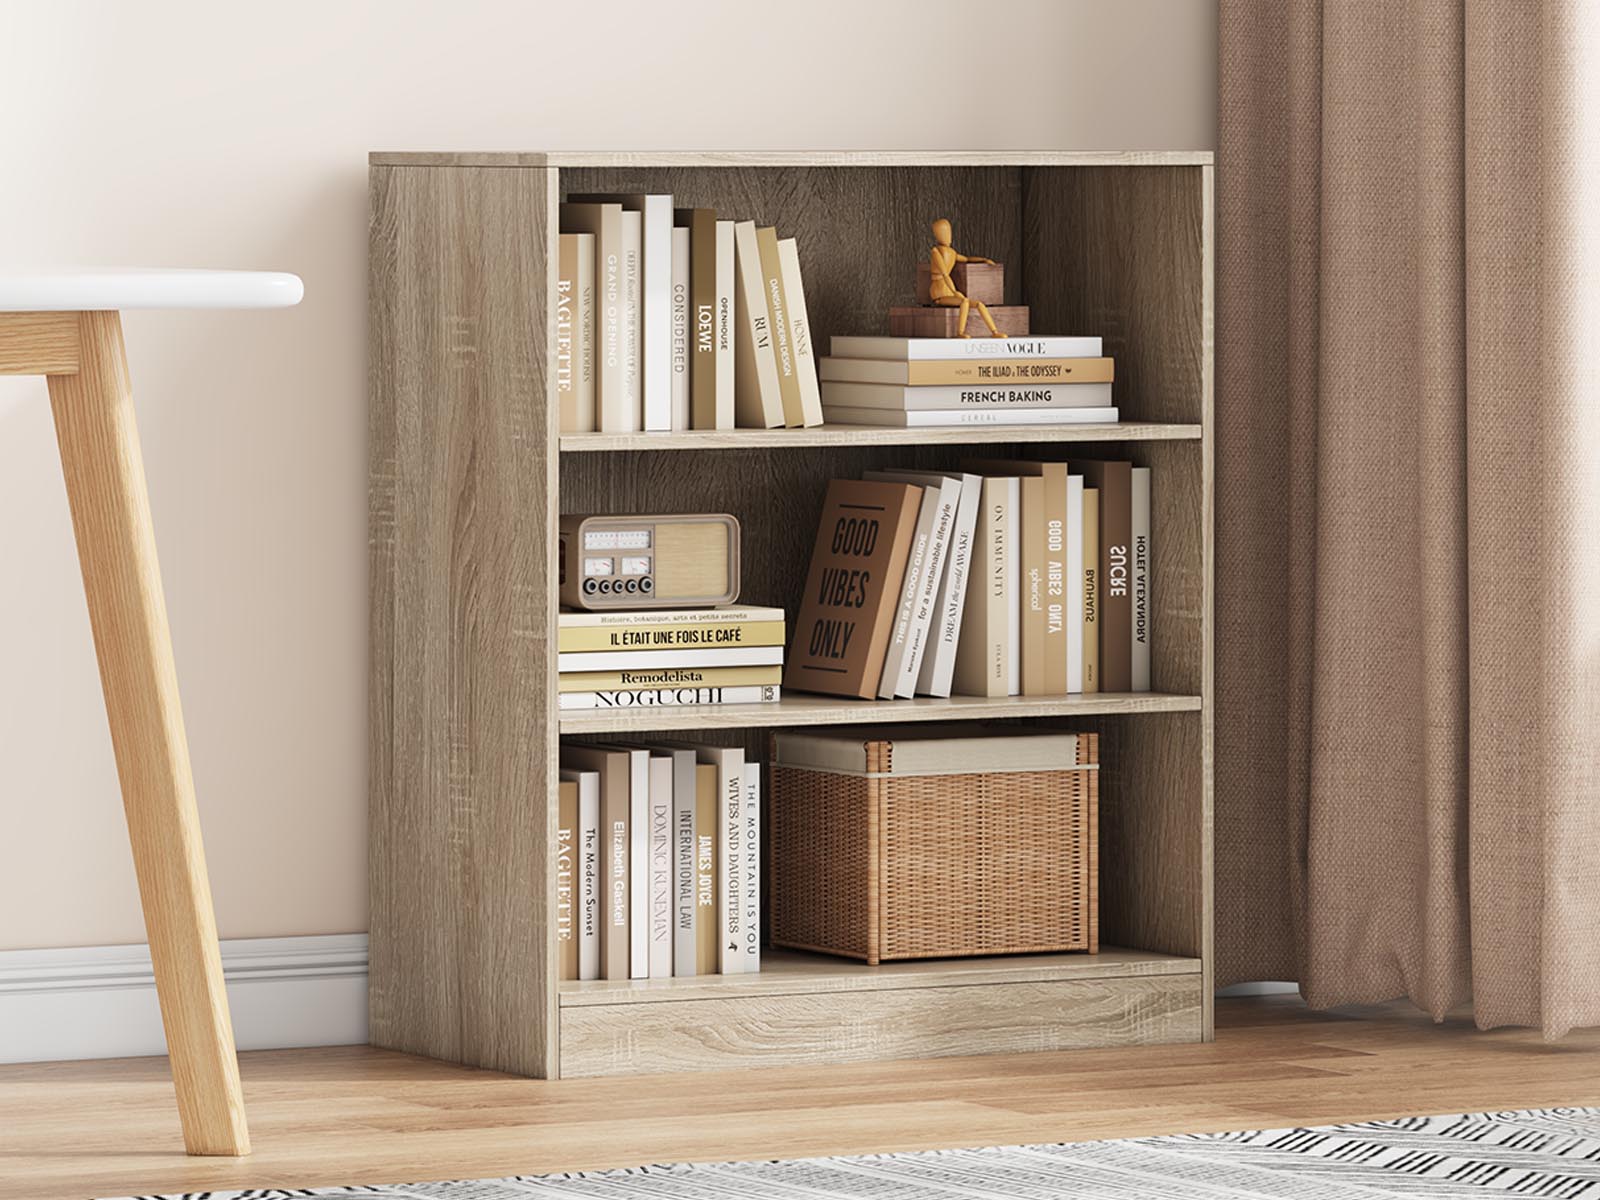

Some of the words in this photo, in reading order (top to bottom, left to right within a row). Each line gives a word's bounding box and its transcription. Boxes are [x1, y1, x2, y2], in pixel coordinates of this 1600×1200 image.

[607, 255, 617, 301] GRAND
[769, 278, 782, 310] DANISH
[558, 280, 571, 392] BAGUETTE
[607, 307, 617, 368] OPENING
[674, 284, 685, 373] CONSIDERED
[699, 305, 712, 353] LOEWE
[720, 297, 729, 350] OPENHOUSE
[754, 317, 769, 349] RUM
[775, 310, 787, 347] MODERN
[781, 347, 792, 377] DESIGN
[964, 343, 1005, 354] UNSEEN
[1006, 342, 1046, 354] VOGUE
[978, 366, 991, 377] THE
[992, 366, 1011, 377] ILIAD
[1016, 365, 1030, 377] THE
[1031, 365, 1062, 377] ODYSSEY
[961, 391, 1006, 403] FRENCH
[1008, 390, 1052, 402] BAKING
[995, 504, 1003, 522] ON
[831, 517, 879, 557] GOOD
[916, 533, 927, 566] GUIDE
[918, 606, 928, 620] for
[925, 542, 943, 596] sustainable
[936, 503, 952, 541] lifestyle
[995, 529, 1003, 597] IMMUNITY
[818, 567, 870, 609] VIBES
[909, 568, 920, 598] GOOD
[945, 602, 959, 643] DREAM
[957, 530, 970, 569] AWAKE
[699, 613, 719, 622] petits
[901, 609, 910, 621] IS
[905, 599, 913, 608] A
[611, 633, 620, 646] IL
[623, 630, 651, 645] ÉTAIT
[653, 631, 674, 644] UNE
[676, 630, 699, 643] FOIS
[701, 629, 713, 642] LE
[716, 626, 742, 642] CAFÉ
[808, 619, 855, 660] ONLY
[896, 621, 907, 644] THIS
[621, 671, 703, 684] Remodelista
[595, 687, 723, 708] NOGUCHI
[728, 777, 739, 819] WIVES
[747, 784, 756, 809] THE
[585, 828, 595, 848] The
[613, 821, 625, 877] Elizabeth
[654, 805, 667, 865] DOMINIC
[698, 835, 712, 870] JAMES
[728, 822, 739, 851] AND
[680, 810, 691, 901] INTERNATIONAL
[747, 817, 756, 898] MOUNTAIN
[558, 829, 571, 941] BAGUETTE
[585, 853, 595, 895] Modern
[698, 873, 712, 906] JOYCE
[613, 880, 625, 926] Gaskell
[654, 870, 667, 942] KUNEMAN
[728, 854, 739, 934] DAUGHTERS
[747, 905, 756, 918] IS
[585, 899, 596, 936] Sunset
[680, 906, 691, 930] LAW
[747, 923, 756, 955] YOU
